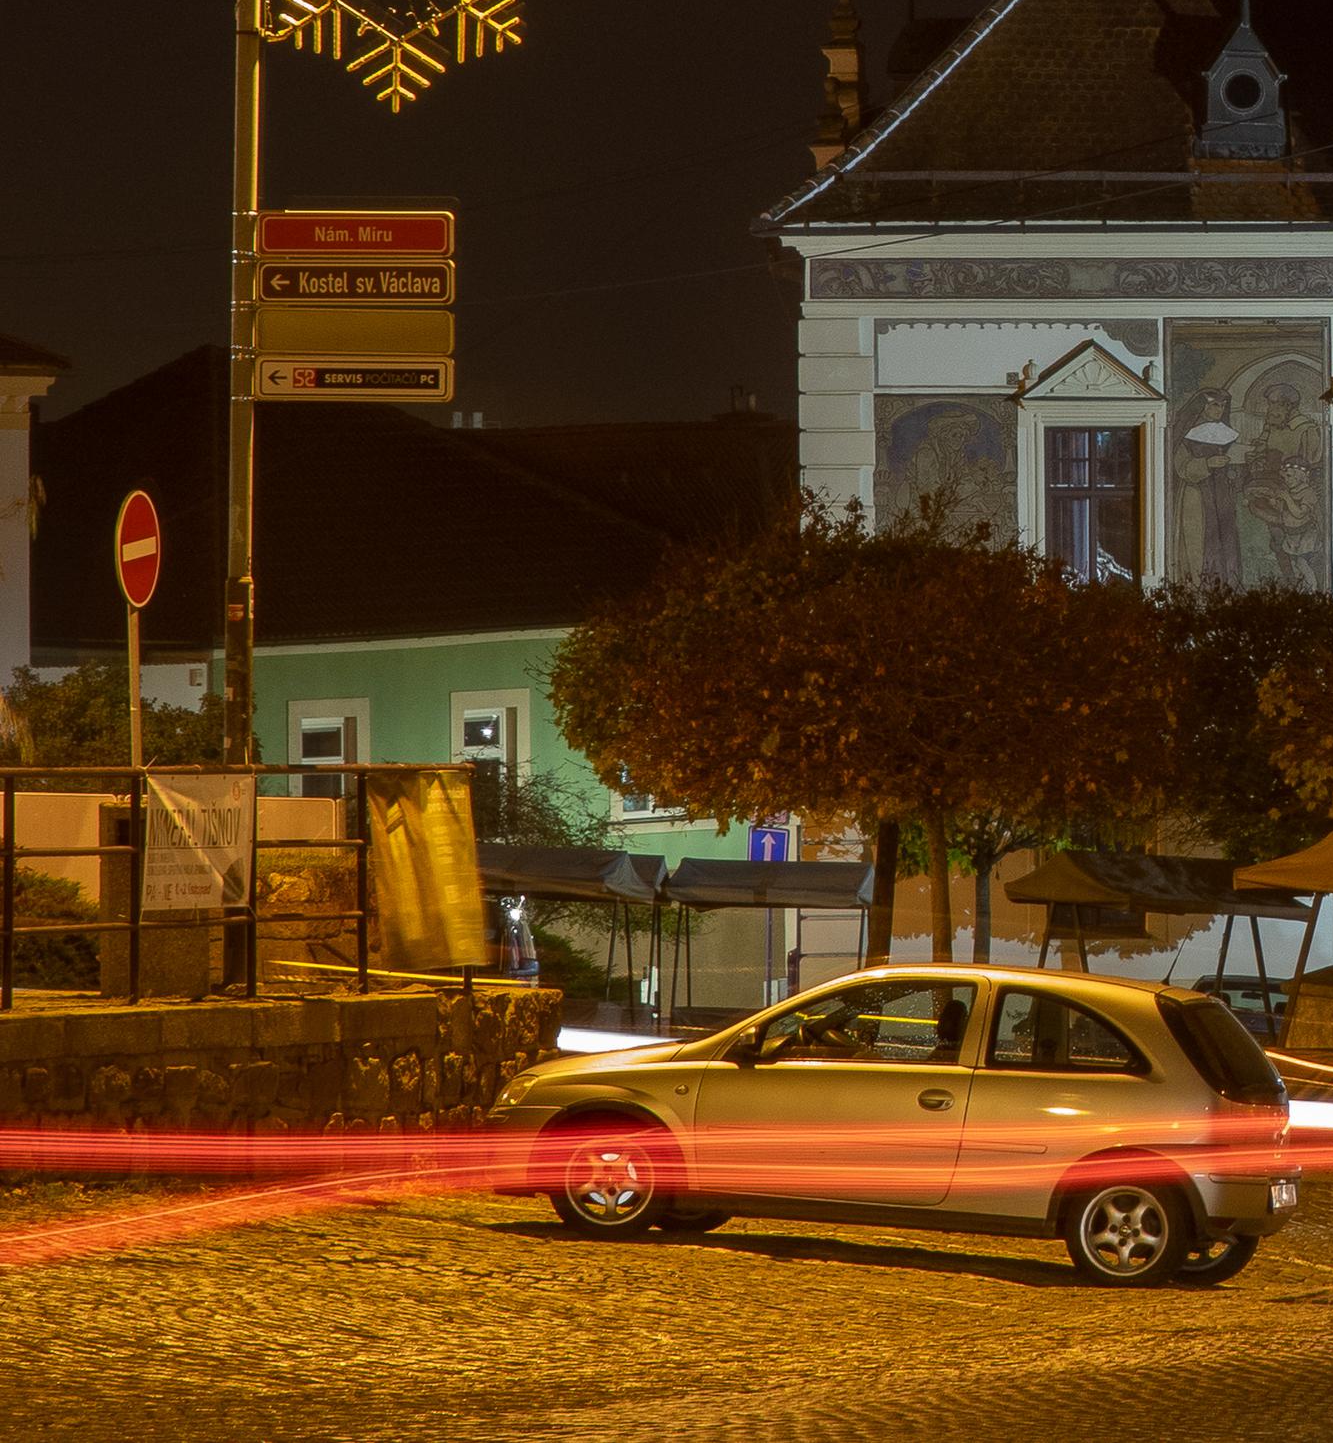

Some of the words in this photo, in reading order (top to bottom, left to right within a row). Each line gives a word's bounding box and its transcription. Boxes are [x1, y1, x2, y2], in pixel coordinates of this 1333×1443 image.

[315, 226, 354, 242] Nám.
[358, 226, 393, 243] Míru
[299, 271, 348, 294] Kostel
[356, 278, 377, 294] sv.
[380, 271, 441, 294] Václava
[324, 373, 363, 384] SERVIS
[420, 374, 435, 385] PC
[201, 801, 241, 847] TIŠNOV
